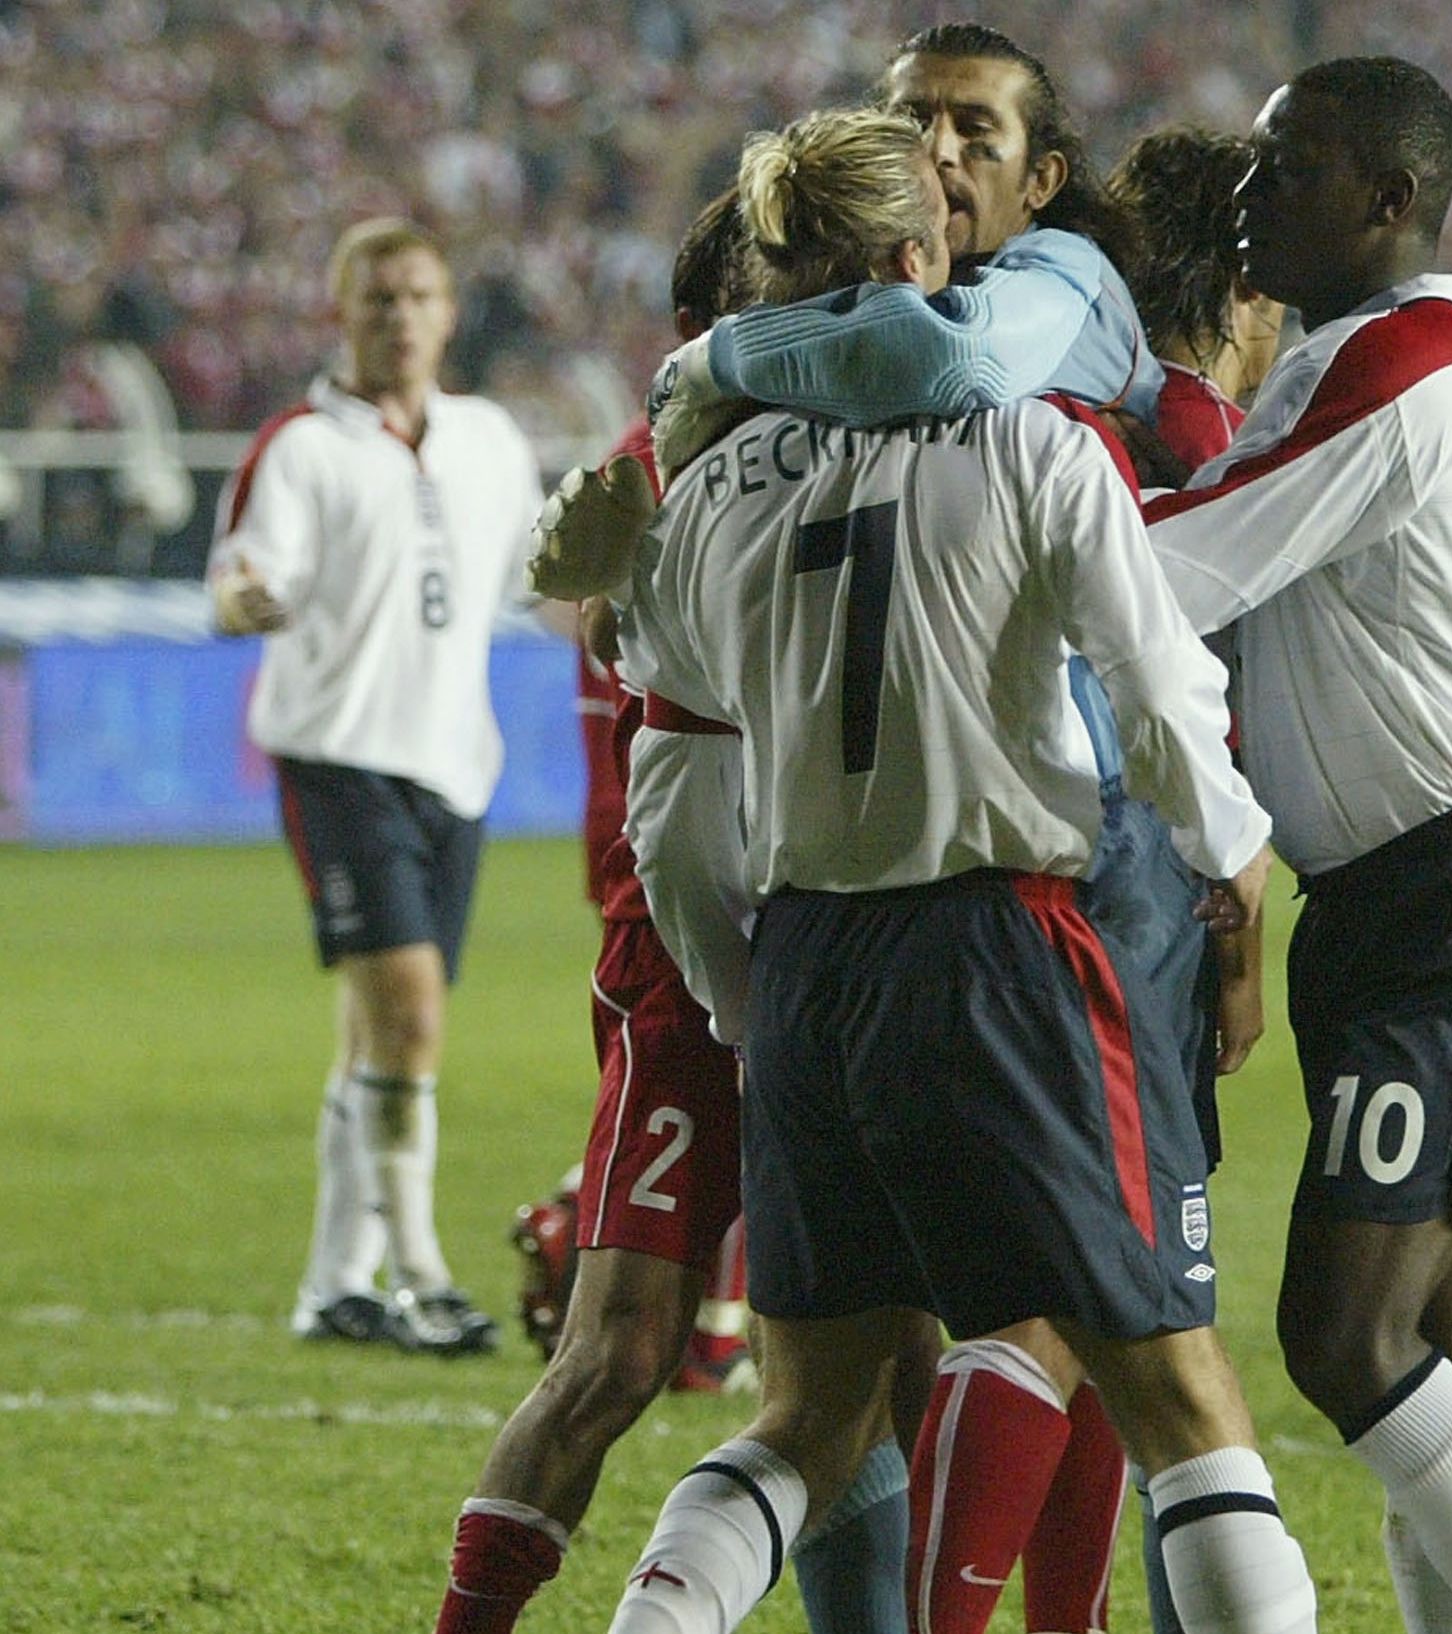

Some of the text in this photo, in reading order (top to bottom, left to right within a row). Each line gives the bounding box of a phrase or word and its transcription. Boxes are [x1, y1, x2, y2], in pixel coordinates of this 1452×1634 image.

[704, 410, 977, 510] BECK
[421, 571, 450, 629] 8
[795, 499, 898, 775] 7
[629, 1106, 694, 1212] 2
[1324, 1075, 1425, 1184] 10
